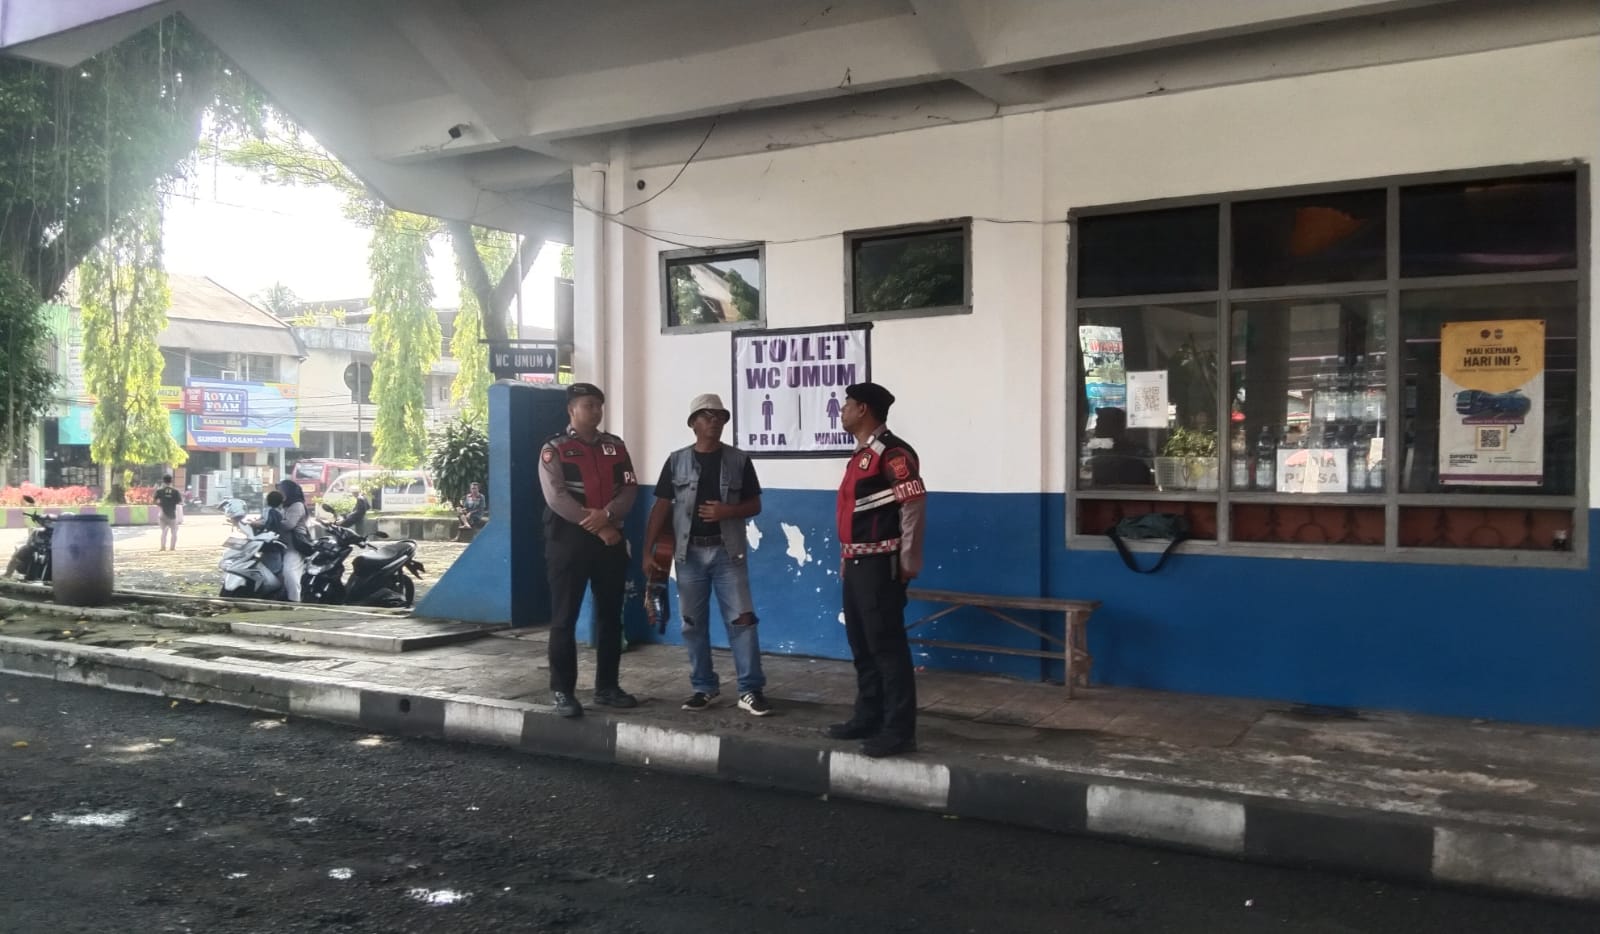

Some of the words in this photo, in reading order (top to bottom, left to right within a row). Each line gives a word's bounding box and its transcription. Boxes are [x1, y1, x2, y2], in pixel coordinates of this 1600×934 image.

[751, 334, 849, 364] TOILET
[1466, 347, 1484, 355] MAU
[1485, 346, 1518, 355] KEMANA
[494, 353, 510, 367] WC
[514, 354, 544, 368] UMUM
[1463, 356, 1492, 367] HARI
[1495, 355, 1511, 366] INI
[746, 366, 781, 390] WC
[786, 363, 856, 389] UMUM
[748, 433, 787, 446] PRIA
[814, 432, 855, 445] WANITA
